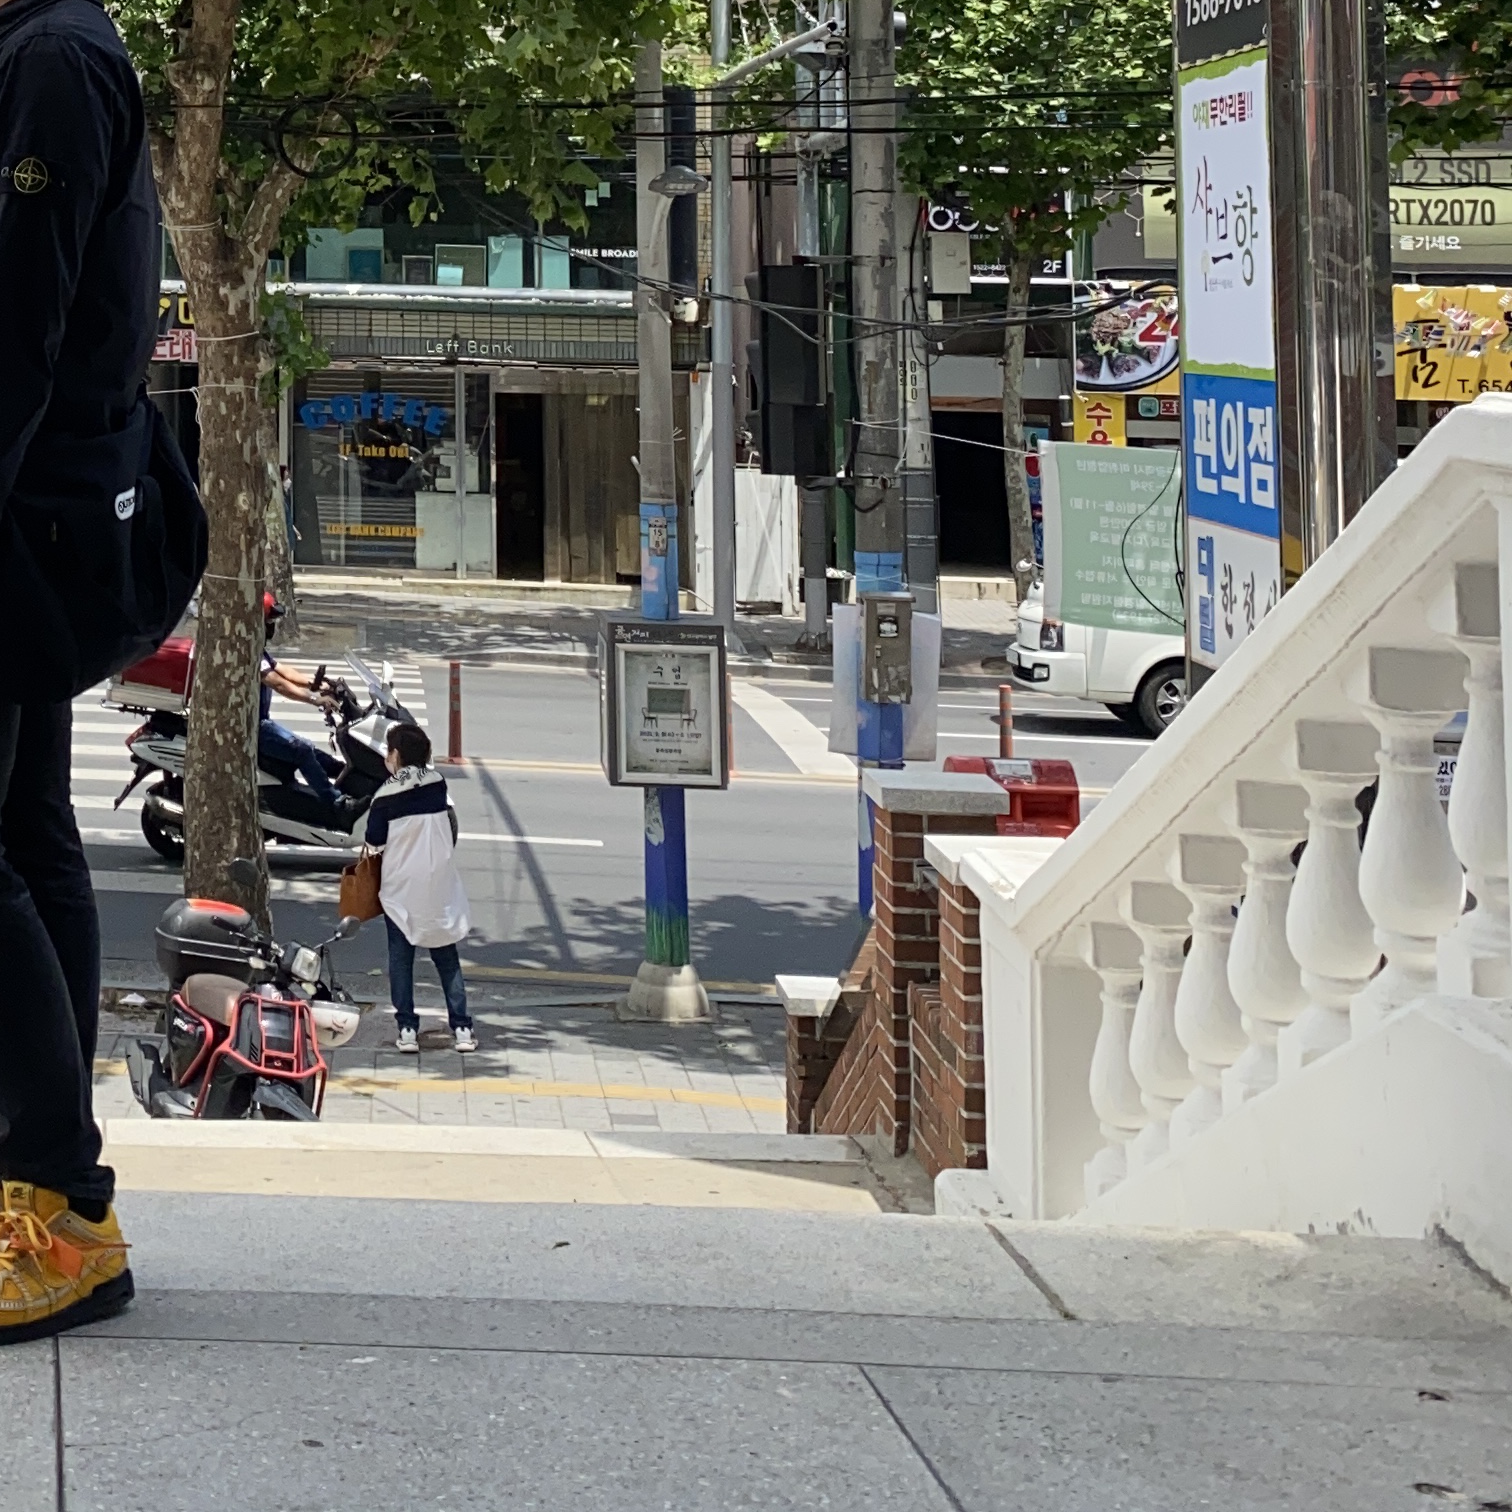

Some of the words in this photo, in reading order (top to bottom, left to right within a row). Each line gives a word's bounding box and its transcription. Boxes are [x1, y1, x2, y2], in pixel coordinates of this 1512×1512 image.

[1439, 159, 1492, 185] SSD
[1399, 235, 1462, 251] 즐기세요
[1042, 259, 1063, 273] 2F
[426, 339, 460, 353] Left
[468, 340, 513, 355] Bank
[299, 391, 448, 436] COFFEE
[357, 444, 386, 458] Take
[1192, 397, 1276, 509] 편의점
